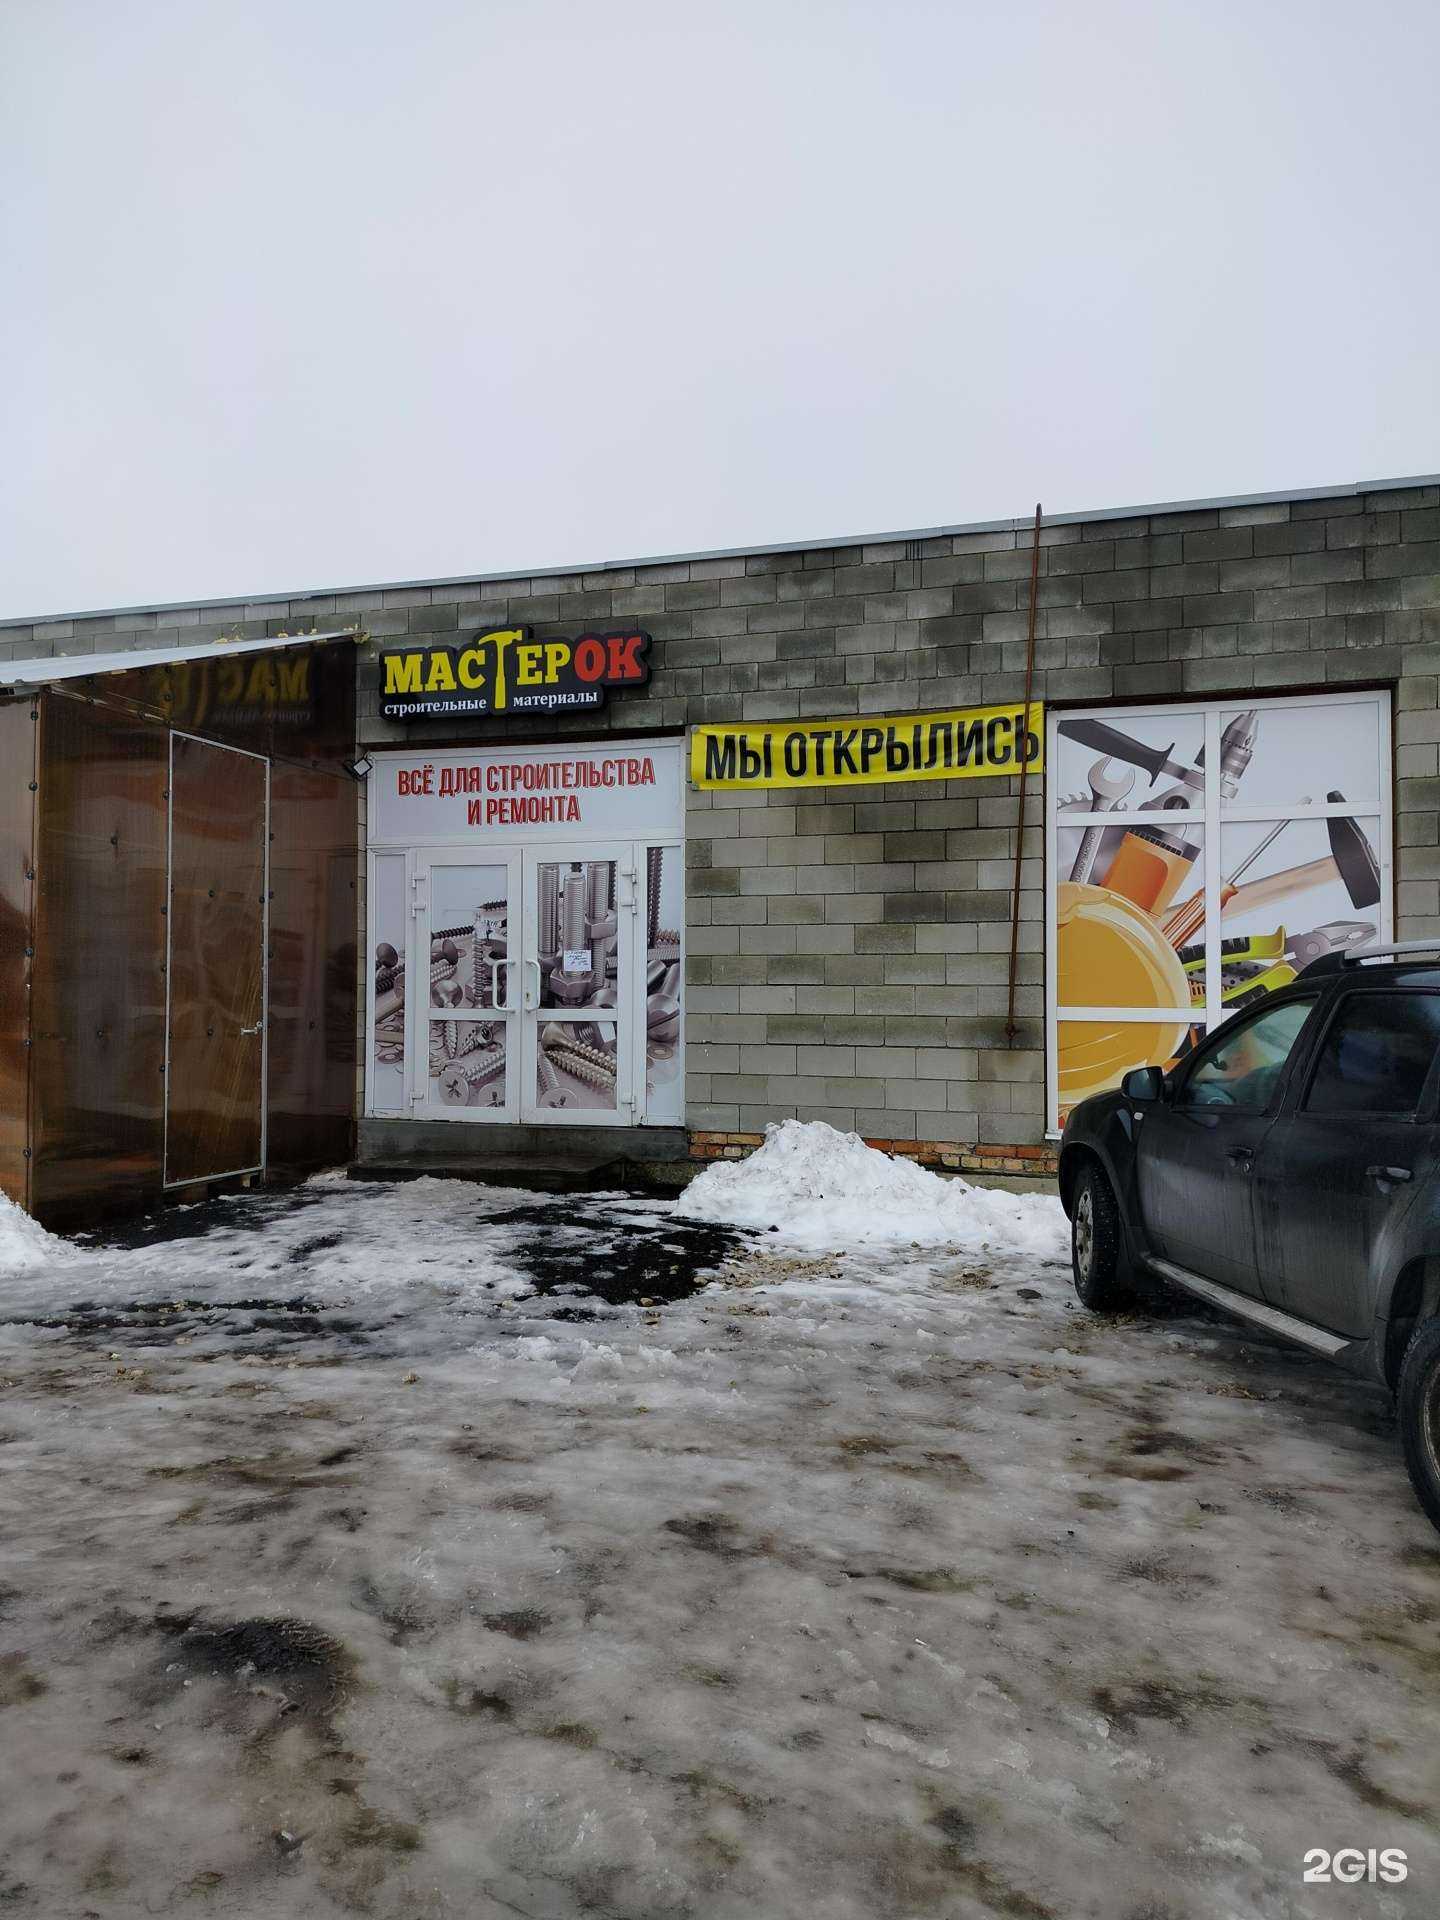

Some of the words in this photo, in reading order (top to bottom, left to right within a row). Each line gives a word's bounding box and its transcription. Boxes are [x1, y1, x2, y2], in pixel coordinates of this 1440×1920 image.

[384, 629, 643, 709] МАСТЕРОК
[384, 698, 487, 717] строительные
[513, 691, 598, 707] материалы
[705, 734, 772, 780] МЫ
[784, 714, 1040, 777] ОТКРЫЛИСЬ
[398, 765, 433, 796] ВСЁ
[438, 767, 481, 797] ДЛЯ
[486, 757, 656, 792] СТРОИТЕЛЬСТВА
[467, 799, 482, 825] И
[486, 795, 581, 826] РЕМОНТА
